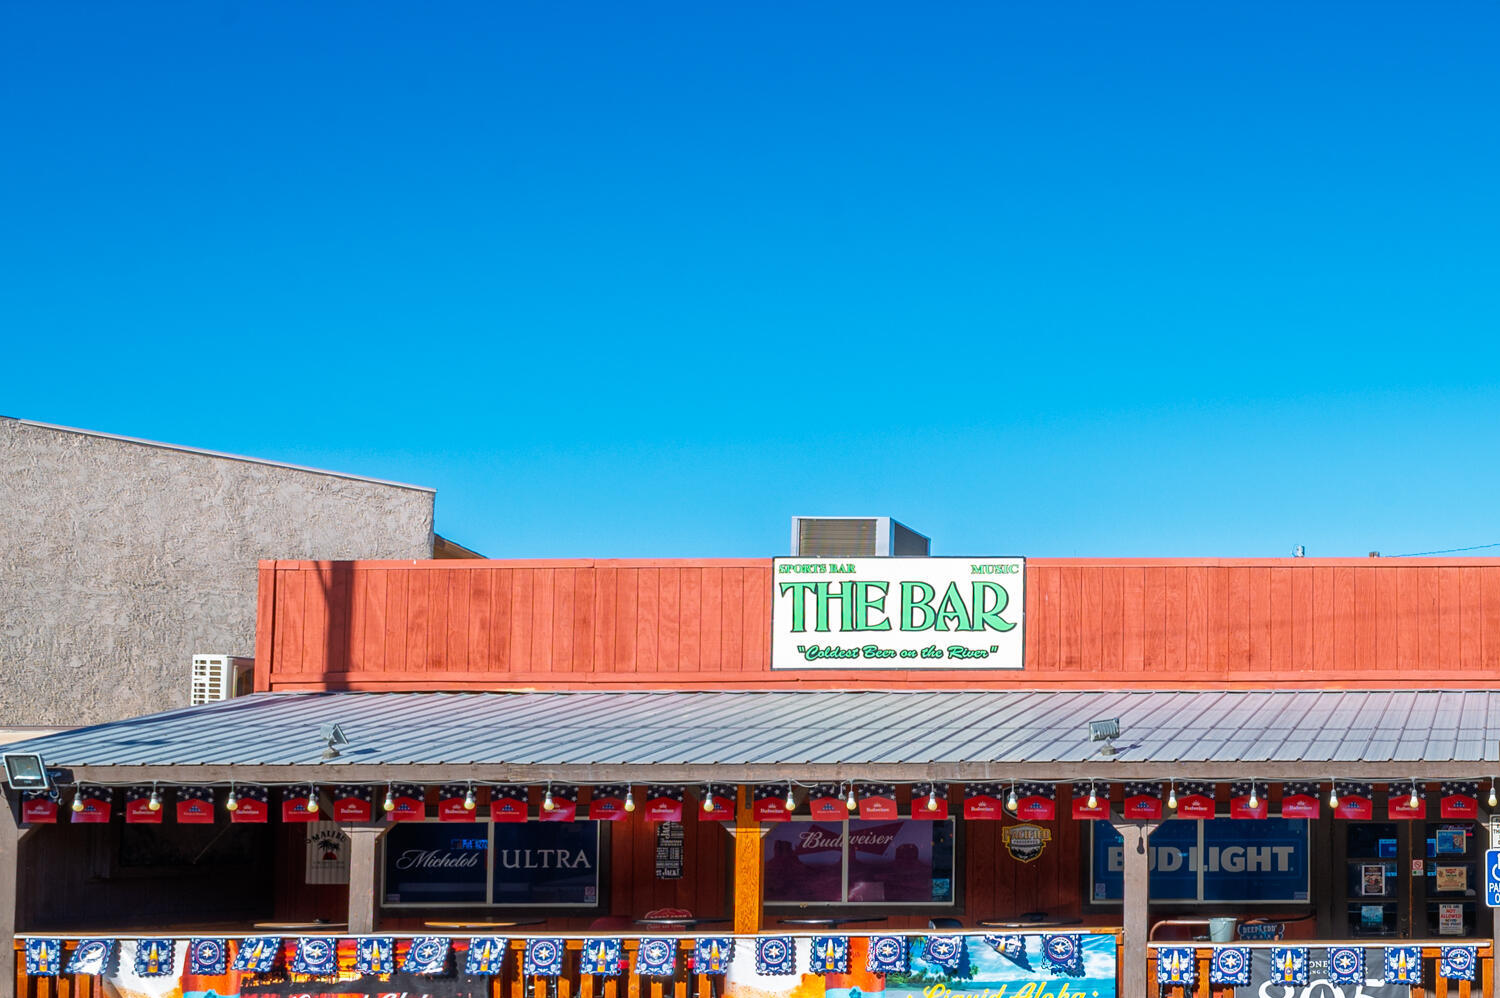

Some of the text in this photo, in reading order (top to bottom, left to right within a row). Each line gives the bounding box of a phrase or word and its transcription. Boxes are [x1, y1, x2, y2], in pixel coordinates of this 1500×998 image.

[778, 563, 856, 574] SPORTS BAR
[970, 564, 1019, 575] MUSIC
[779, 580, 1018, 633] THE BAR
[862, 645, 897, 659] Beer
[899, 649, 917, 658] on
[920, 645, 943, 659] the
[799, 831, 893, 849] Budweiser
[396, 849, 479, 870] Michelob
[502, 849, 591, 869] ULTRA
[1188, 846, 1295, 873] LIGHT
